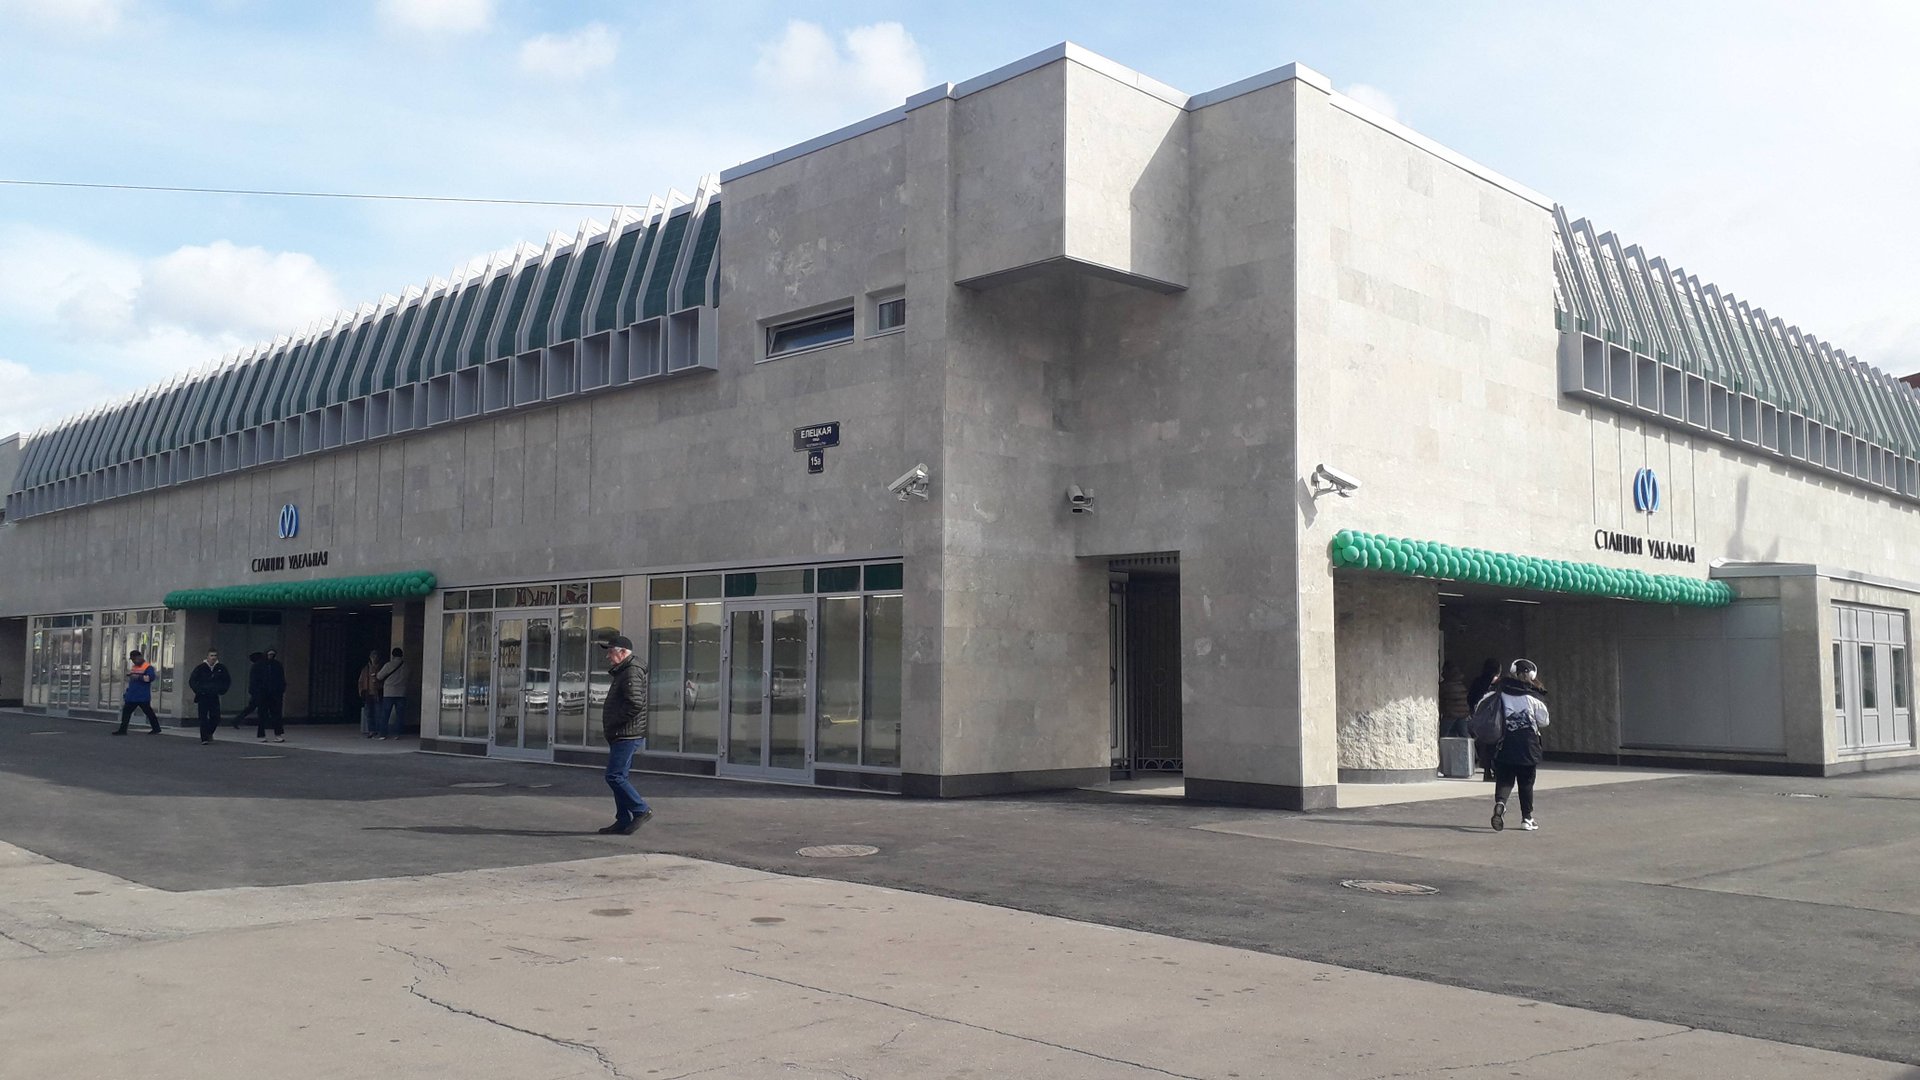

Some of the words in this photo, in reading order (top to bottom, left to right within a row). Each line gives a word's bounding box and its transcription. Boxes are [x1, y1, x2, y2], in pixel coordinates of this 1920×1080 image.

[801, 426, 832, 439] ЕЛЕЦКАЯ
[1594, 529, 1643, 555] СТАНЦИЯ
[1647, 539, 1696, 563] УДЕЛЬНАЯ
[251, 556, 285, 573] СТАНЦИЯ
[288, 551, 329, 570] УДЕЛЬНАЯ
